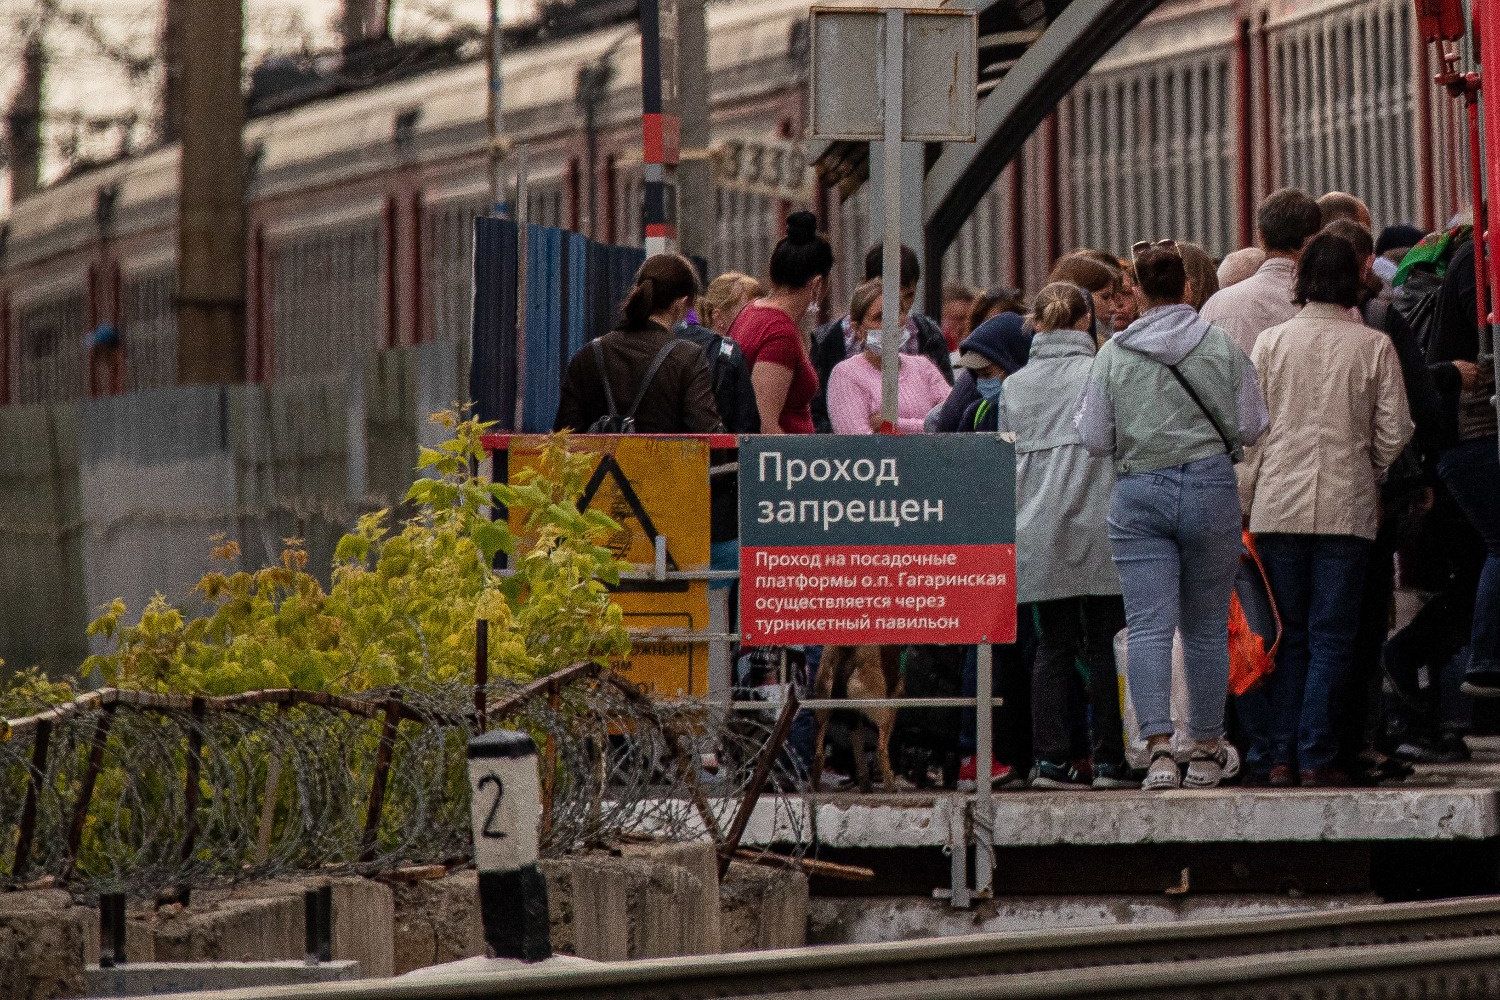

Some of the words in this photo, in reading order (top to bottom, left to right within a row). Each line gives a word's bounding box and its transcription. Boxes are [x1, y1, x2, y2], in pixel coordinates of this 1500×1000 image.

[758, 451, 900, 490] Проход
[757, 499, 944, 531] запрещен
[755, 552, 821, 570] Проход
[825, 555, 846, 566] на
[851, 552, 957, 568] посадочные
[755, 574, 857, 592] платформы
[861, 575, 893, 588] о.п.
[898, 572, 1006, 590] Гагаринская
[755, 596, 891, 613] осуществляется
[896, 595, 946, 611] через
[755, 615, 871, 634] турникетный
[875, 616, 959, 630] павильон
[477, 774, 508, 839] 2
